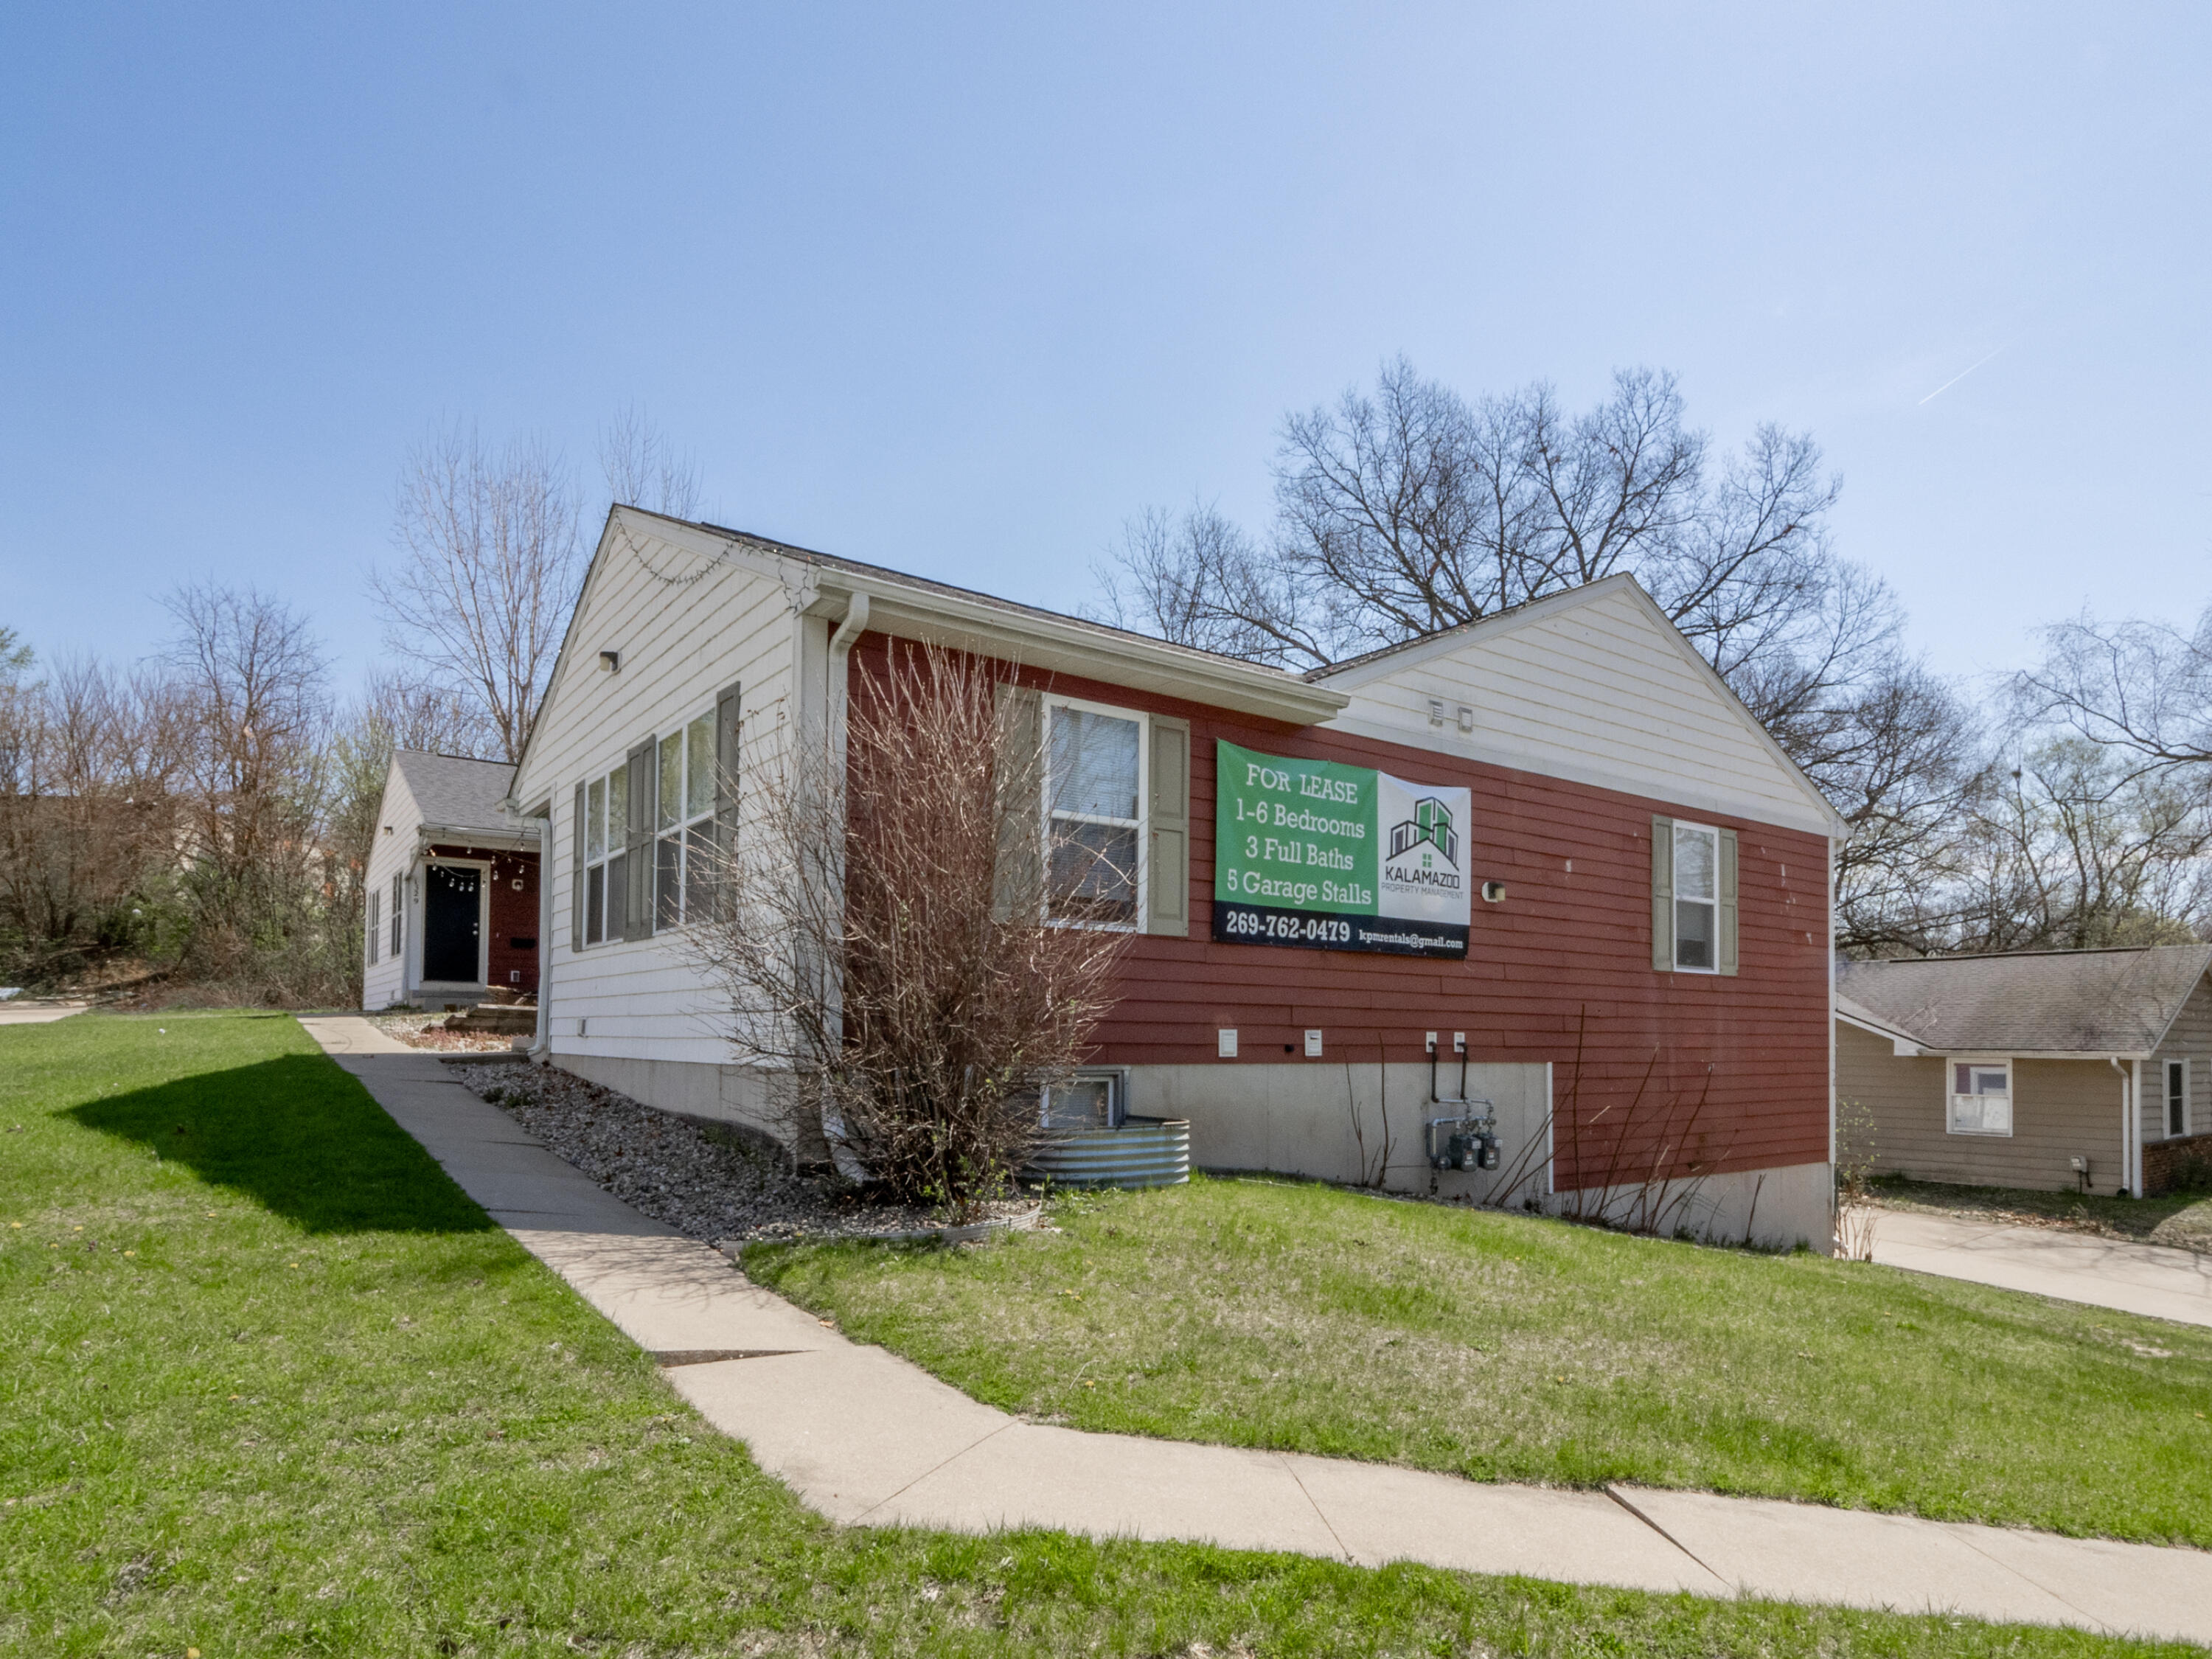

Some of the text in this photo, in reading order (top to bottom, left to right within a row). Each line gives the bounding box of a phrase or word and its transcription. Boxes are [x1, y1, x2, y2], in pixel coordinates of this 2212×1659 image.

[1246, 763, 1357, 804] FOR LEASE
[1237, 798, 1366, 838] 1-6 Bedrooms
[1245, 835, 1354, 870] 3 Full Baths
[1228, 869, 1372, 905] 5 Garage Stalls
[1381, 882, 1464, 900] PROPERTY MANAGEMENT
[1385, 866, 1460, 889] KALAMAZOO
[1226, 911, 1351, 942] 269-762-0479
[1359, 929, 1464, 948] kpmrentals@gmail.com
